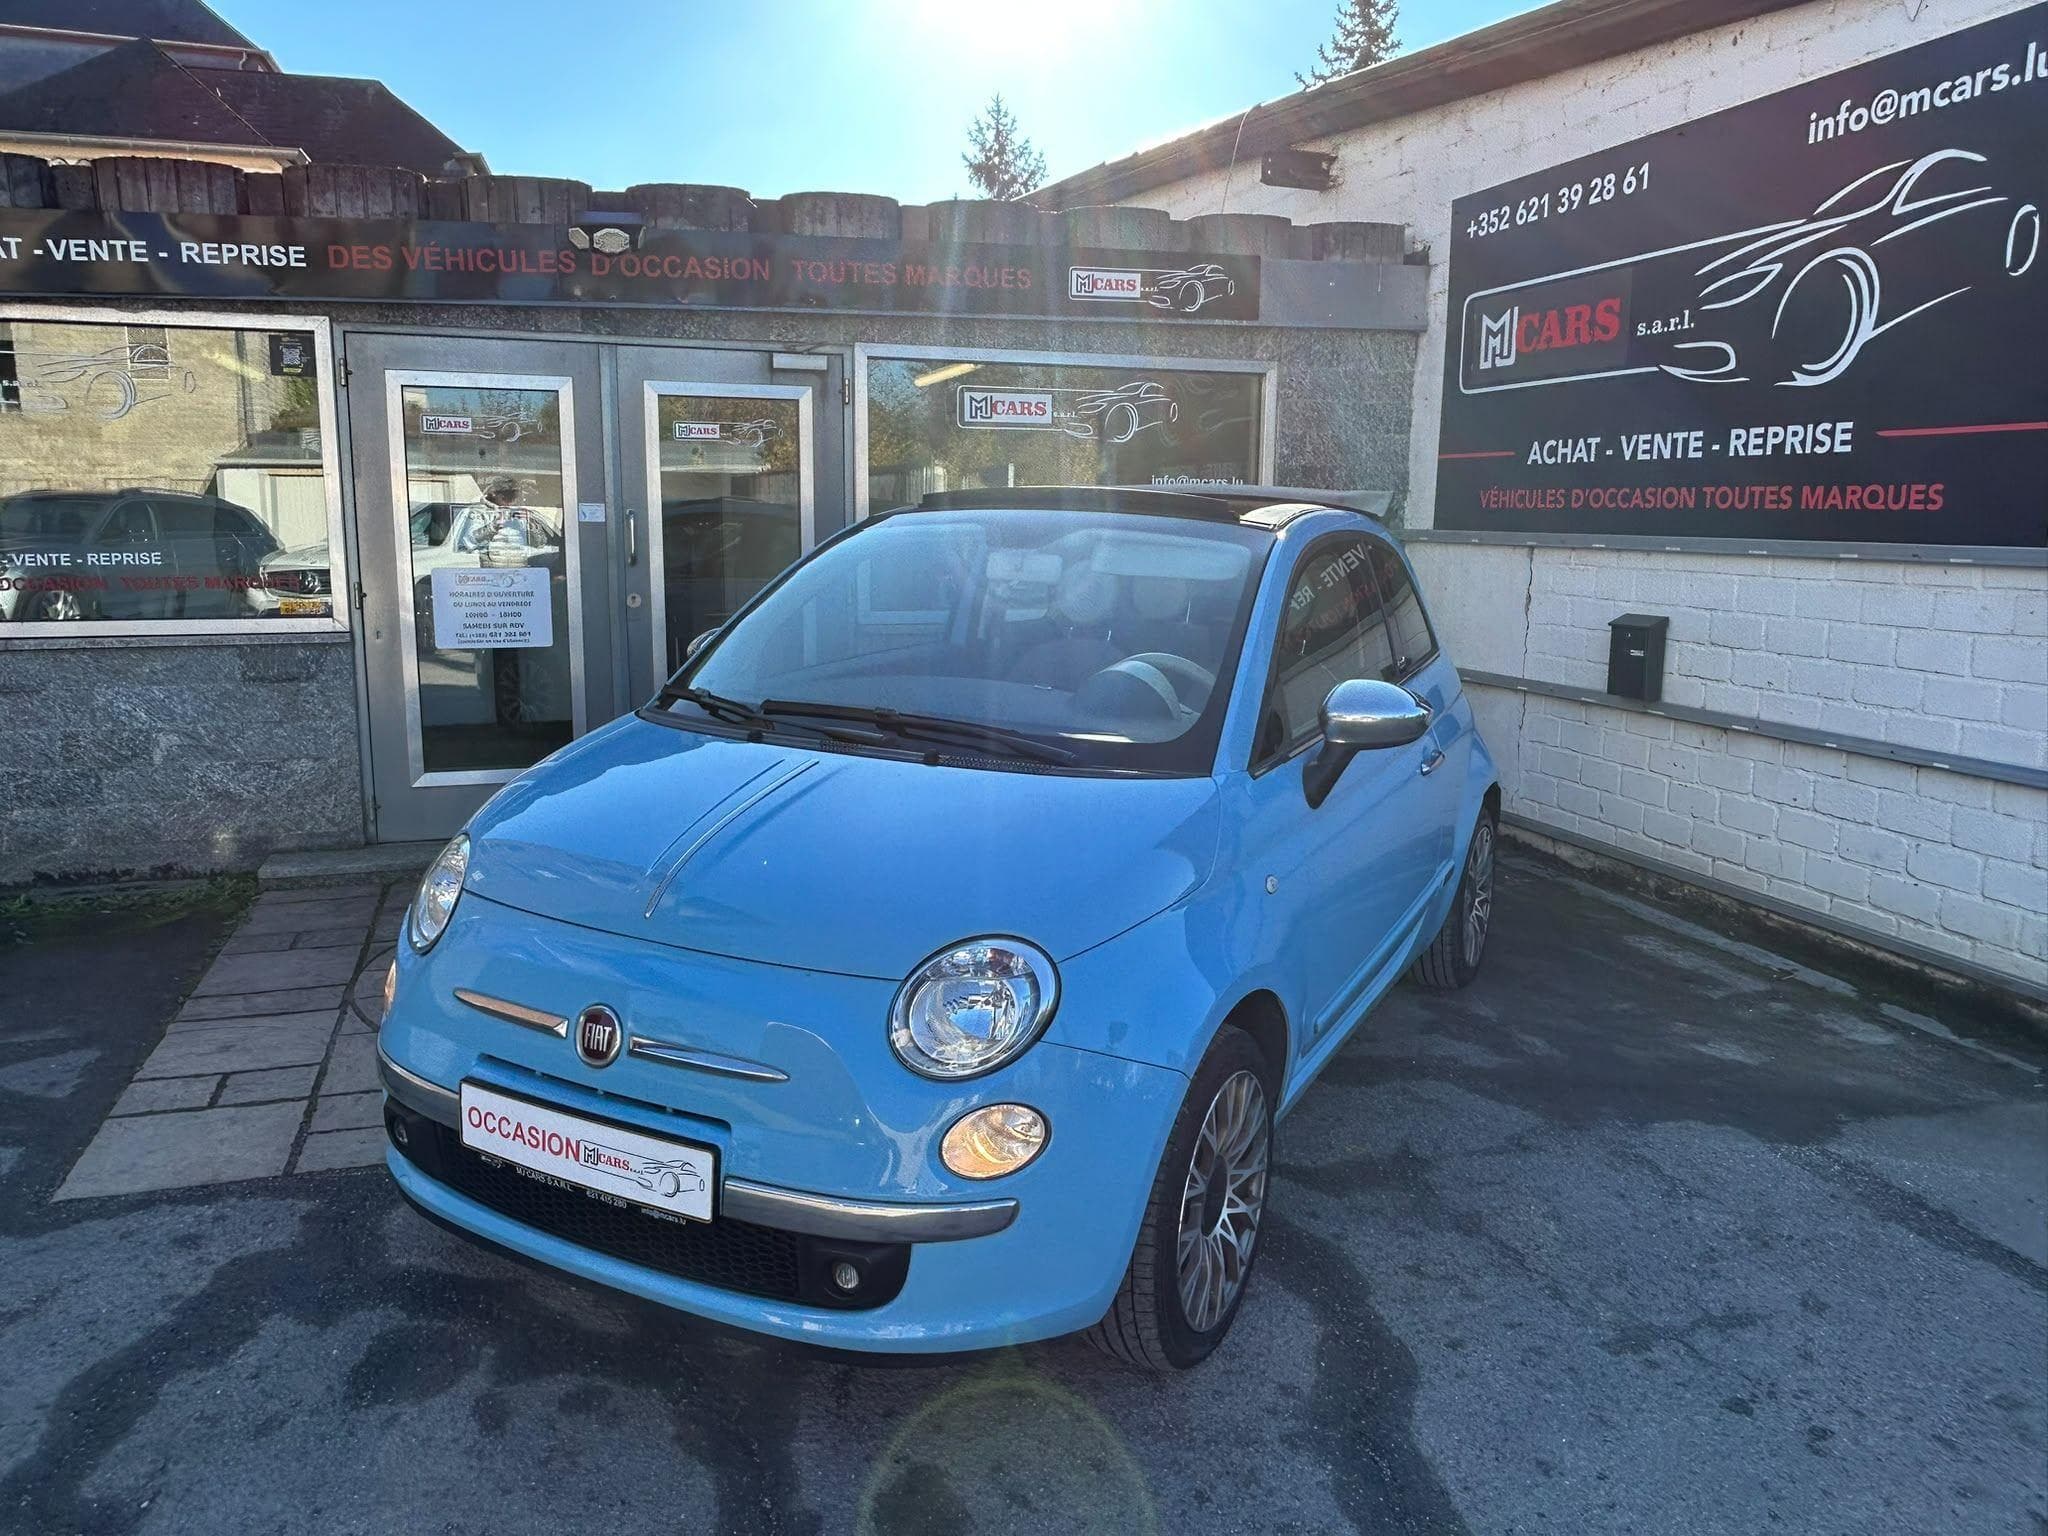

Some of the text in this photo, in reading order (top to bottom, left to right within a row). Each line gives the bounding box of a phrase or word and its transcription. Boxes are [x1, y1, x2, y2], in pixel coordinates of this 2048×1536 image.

[1808, 41, 2048, 145] info@mcars.lu
[1466, 161, 1649, 238] +352 621 39 28 61
[180, 242, 307, 267] REPRISE
[327, 244, 393, 271] DES
[401, 240, 577, 274] VÉHICULES
[591, 252, 770, 281] D'OCCASION
[791, 259, 897, 285] TOUTES
[905, 263, 1032, 290] MARQUES
[1636, 309, 1695, 336] s.a.r.l.
[1527, 437, 1600, 465] ACHAT
[1621, 430, 1704, 461] VENTE
[1729, 421, 1854, 457] REPRISE
[1479, 483, 1945, 510] VÉHICULES D'OCCASION TOUTES MARQUES
[12, 553, 71, 567] VENTE
[87, 552, 162, 566] REPRISE
[584, 1022, 613, 1053] FIAT
[467, 1105, 580, 1163] OCCASION
